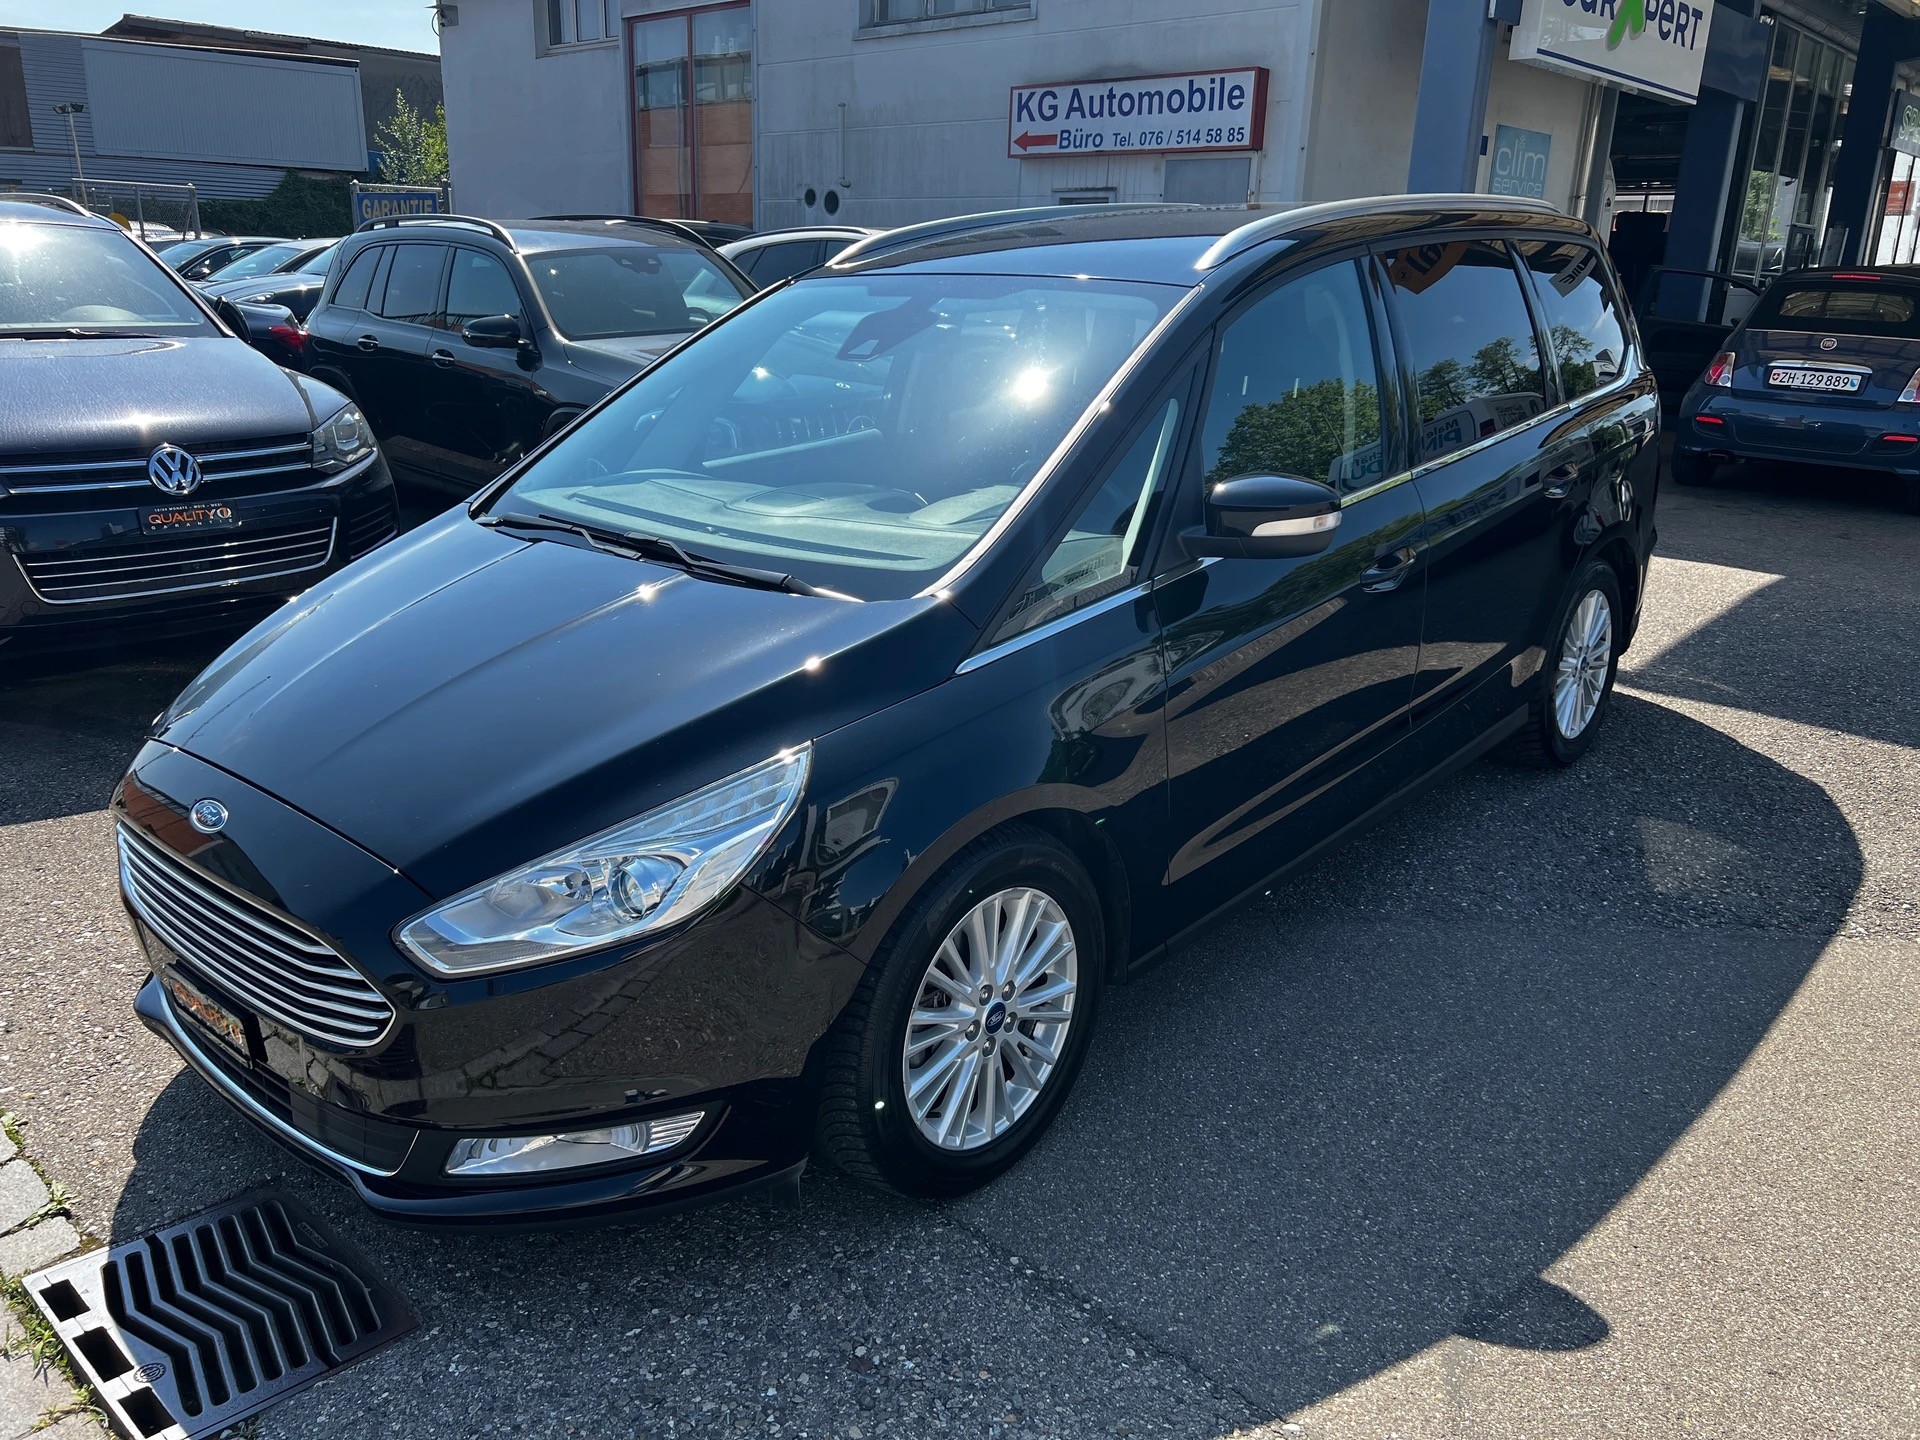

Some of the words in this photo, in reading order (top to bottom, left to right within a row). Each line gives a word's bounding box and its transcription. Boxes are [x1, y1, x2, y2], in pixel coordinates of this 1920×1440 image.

[1016, 90, 1058, 122] KG
[1065, 77, 1245, 120] Automobile
[1058, 128, 1104, 149] Büro
[1112, 132, 1135, 147] Tel.
[1139, 131, 1163, 146] 076
[1176, 128, 1201, 144] 514
[1205, 127, 1222, 143] 58
[1227, 126, 1245, 143] 85
[1496, 137, 1545, 180] clim
[1492, 177, 1542, 198] service
[362, 199, 433, 219] GARANTIE
